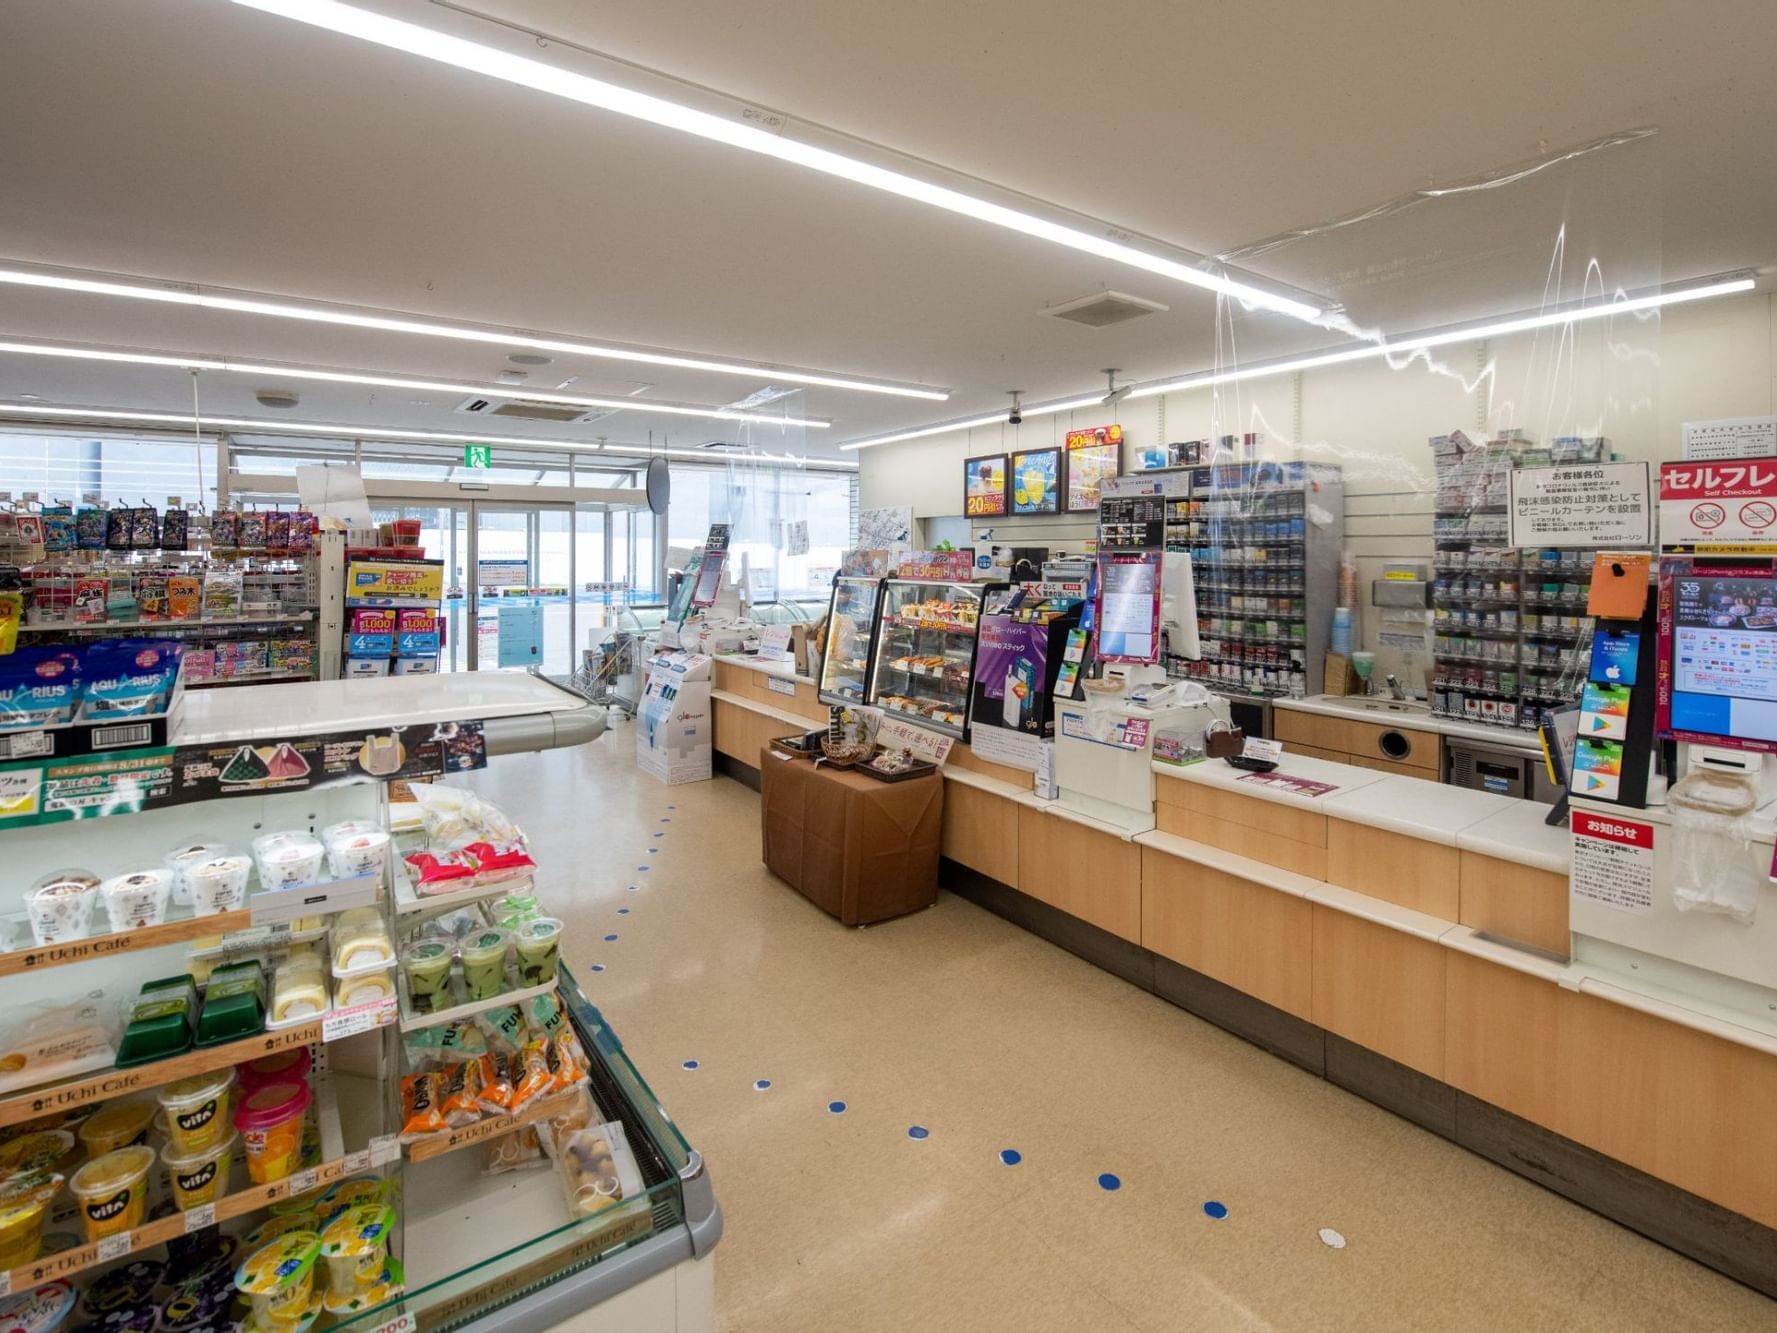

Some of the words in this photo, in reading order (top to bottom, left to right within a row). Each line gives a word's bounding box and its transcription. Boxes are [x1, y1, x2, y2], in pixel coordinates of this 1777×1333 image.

[1552, 470, 1604, 480] お客様各位
[1664, 465, 1777, 491] セルフレ
[1517, 493, 1641, 506] 飛沫感染防止対策として
[1704, 489, 1720, 497] Self
[1722, 488, 1762, 496] Checkout
[1518, 504, 1642, 516] ビニールカーテンを設置
[1023, 584, 1041, 596] 太く
[1587, 820, 1637, 839] お知らせ
[50, 943, 88, 962] Uchi
[93, 935, 130, 951] Café
[286, 1026, 318, 1045] Uchi
[57, 1085, 96, 1105] Uchi
[102, 1074, 140, 1092] Café
[466, 1125, 493, 1140] Uchi
[495, 1115, 520, 1129] Café
[58, 1250, 98, 1270] Uchi
